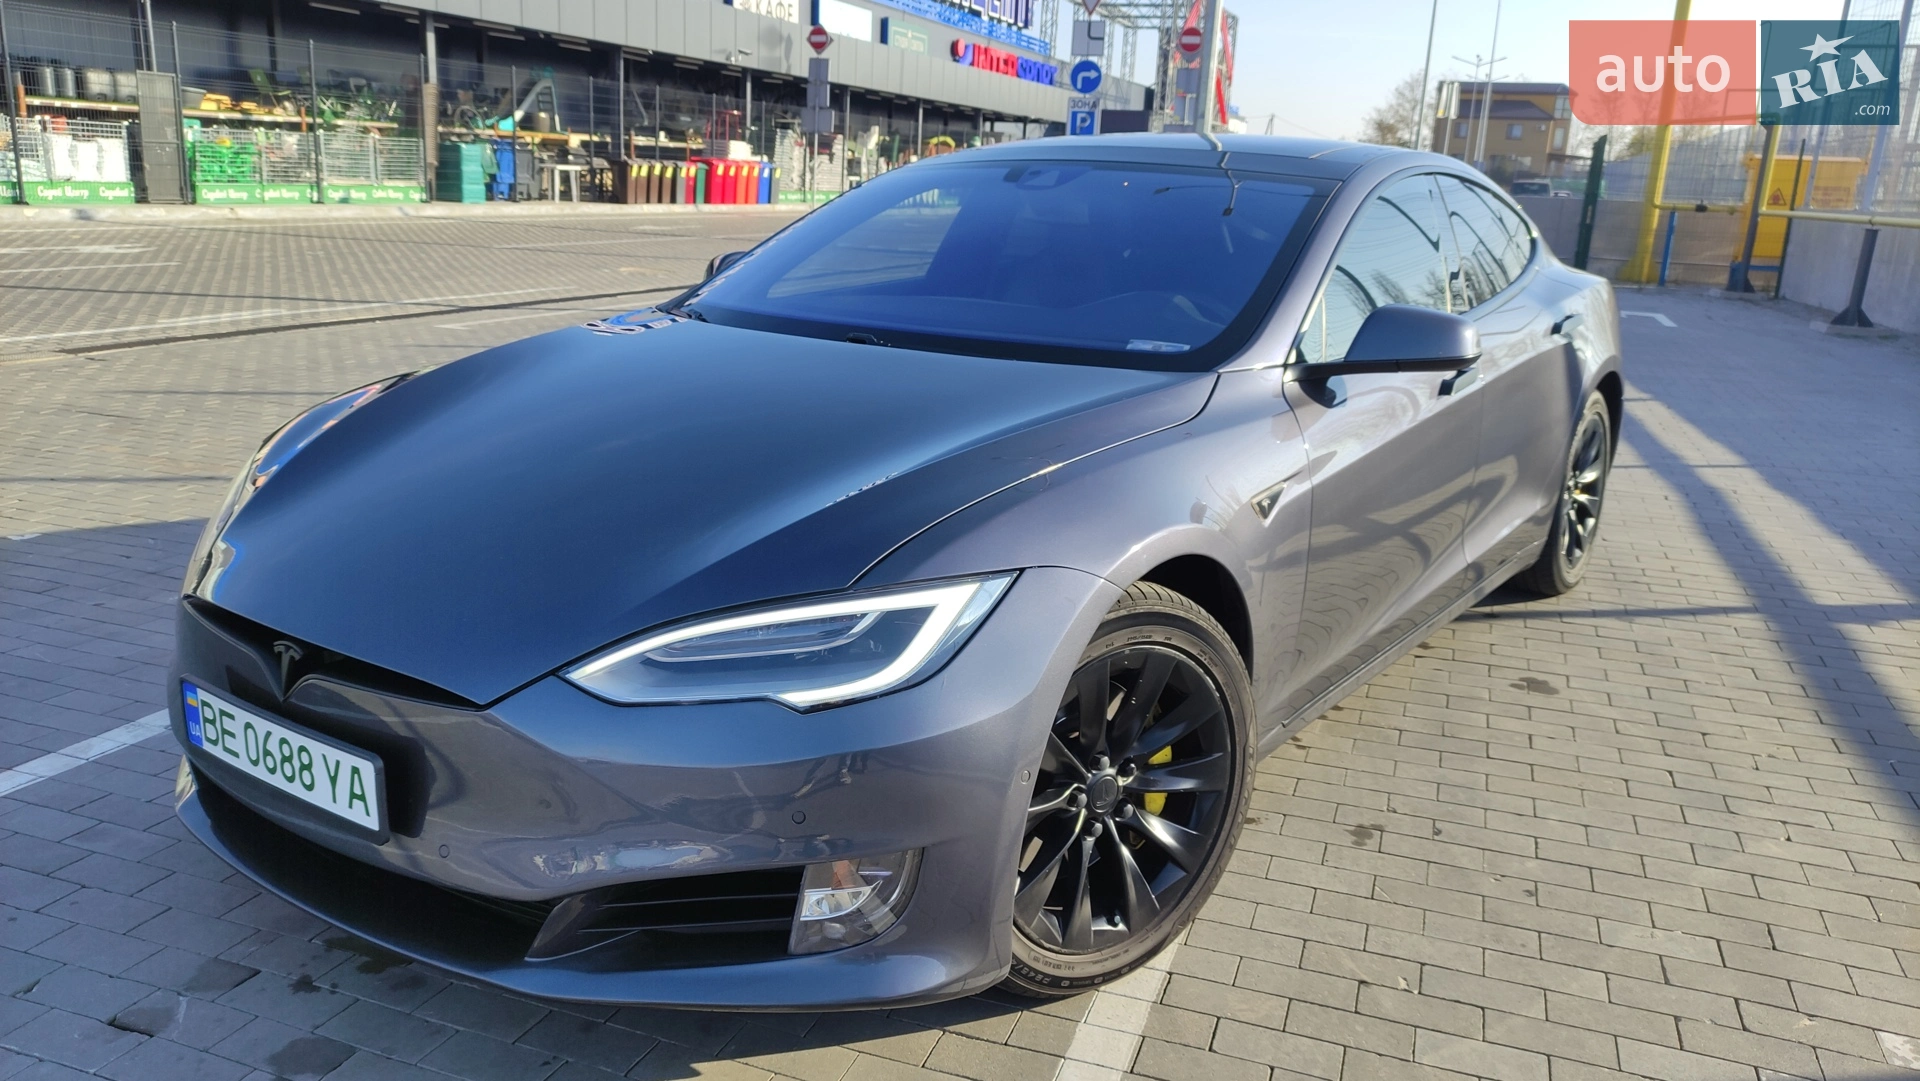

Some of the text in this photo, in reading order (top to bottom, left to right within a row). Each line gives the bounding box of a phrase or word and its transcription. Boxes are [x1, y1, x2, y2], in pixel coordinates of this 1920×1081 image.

[1070, 99, 1097, 110] ЗОНА
[189, 720, 202, 739] UA
[200, 698, 371, 818] BE 0688 YA
